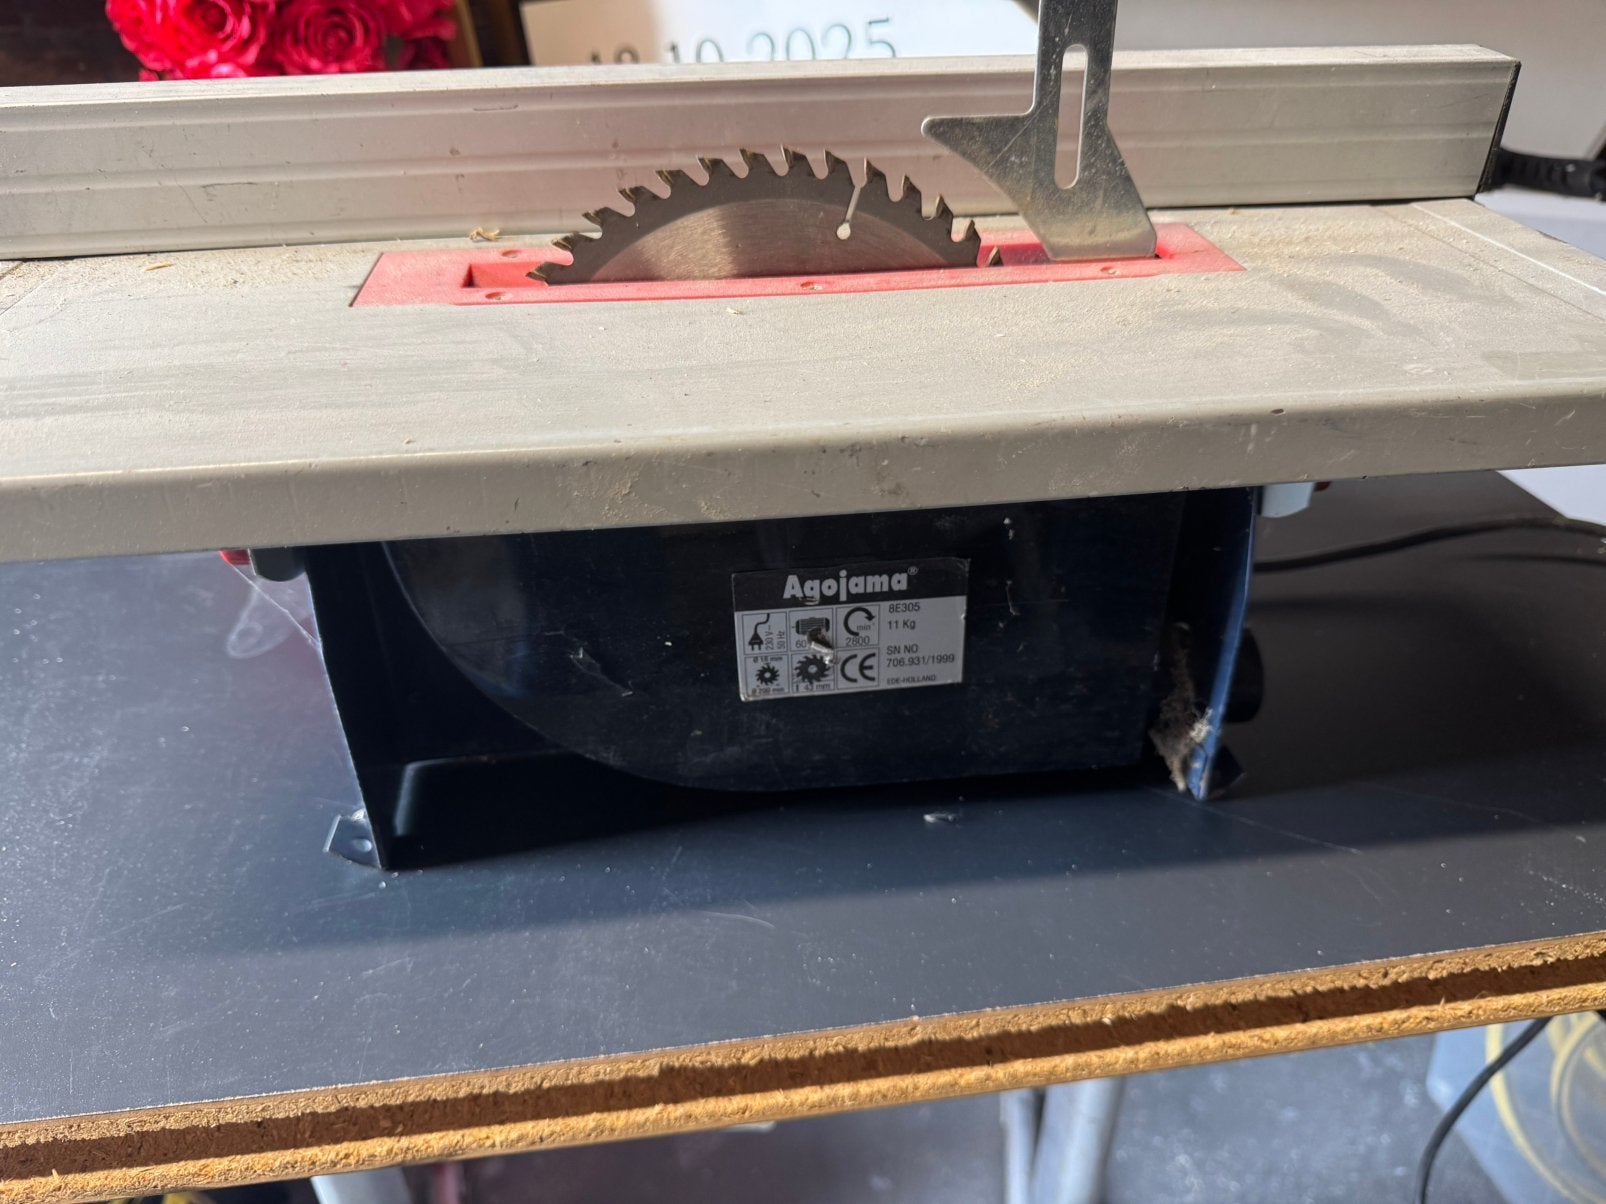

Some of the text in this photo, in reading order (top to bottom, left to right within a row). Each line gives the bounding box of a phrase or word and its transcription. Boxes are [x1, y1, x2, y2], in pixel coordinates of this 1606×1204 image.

[888, 601, 921, 614] 8E305
[887, 619, 916, 630] 11 Kg
[846, 635, 870, 648] 2800
[886, 643, 919, 655] SN NO
[886, 653, 955, 668] 706.931/1999
